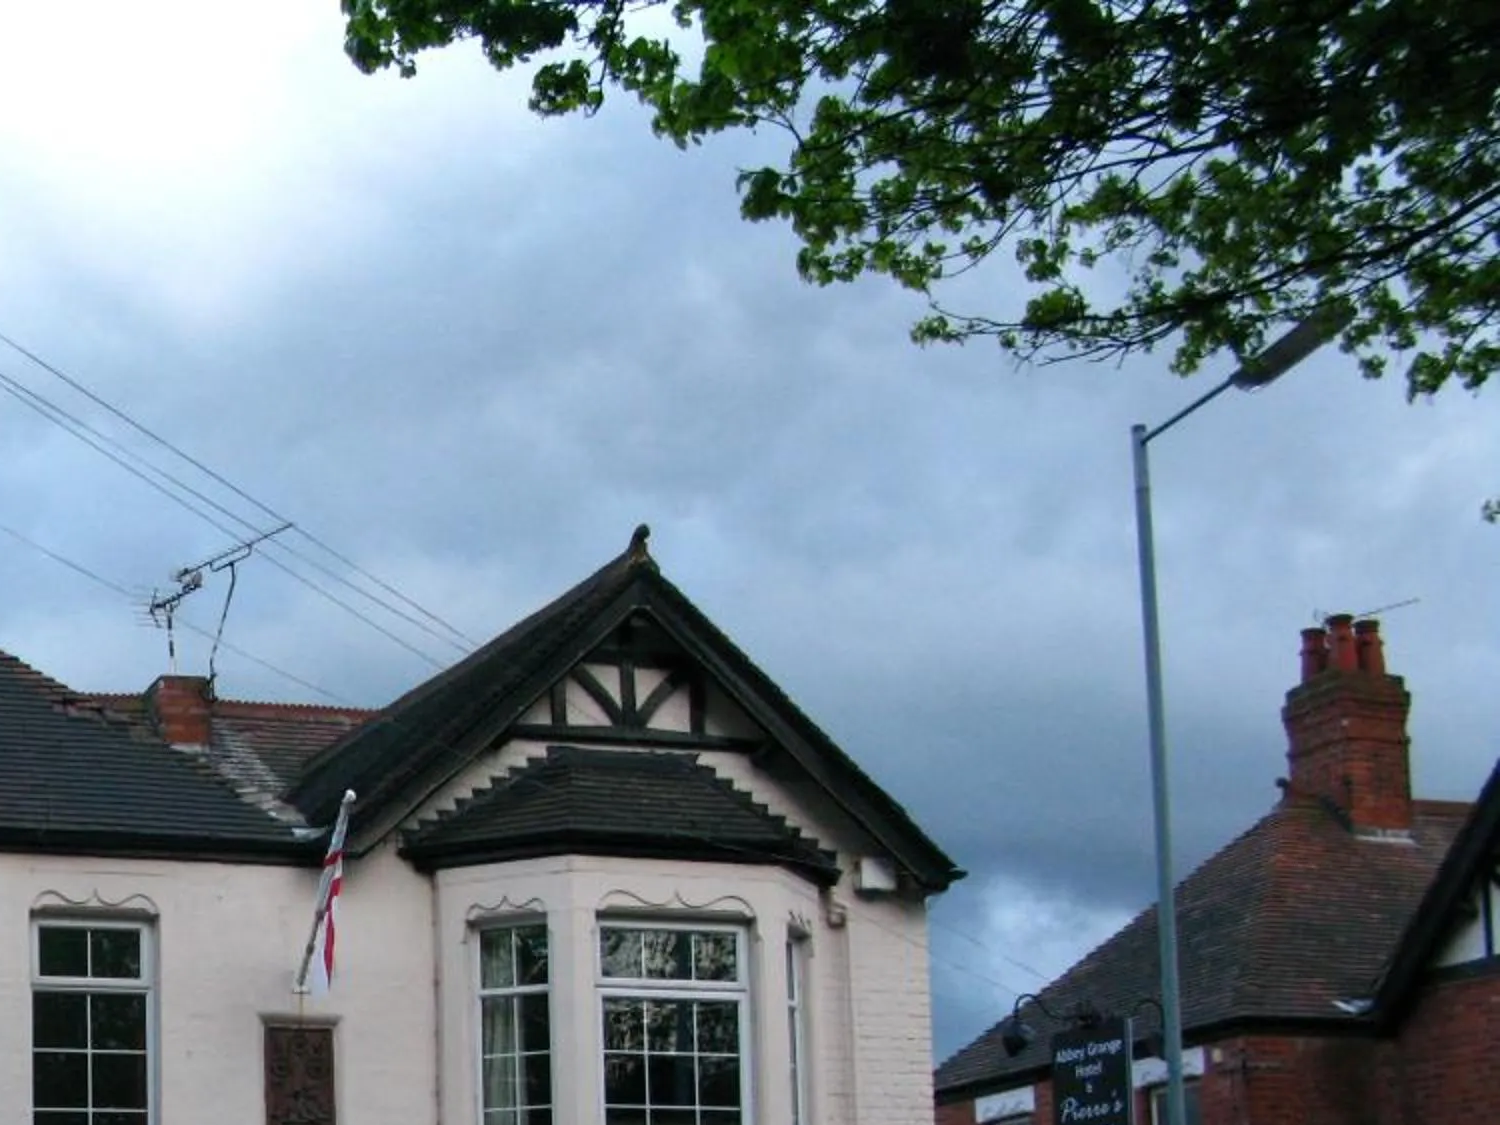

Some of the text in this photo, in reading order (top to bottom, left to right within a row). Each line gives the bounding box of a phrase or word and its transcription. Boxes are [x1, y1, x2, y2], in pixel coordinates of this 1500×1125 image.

[1055, 1039, 1122, 1063] Abbey Grange
[1075, 1060, 1102, 1078] Hotel
[1060, 1088, 1123, 1123] Pierre's
